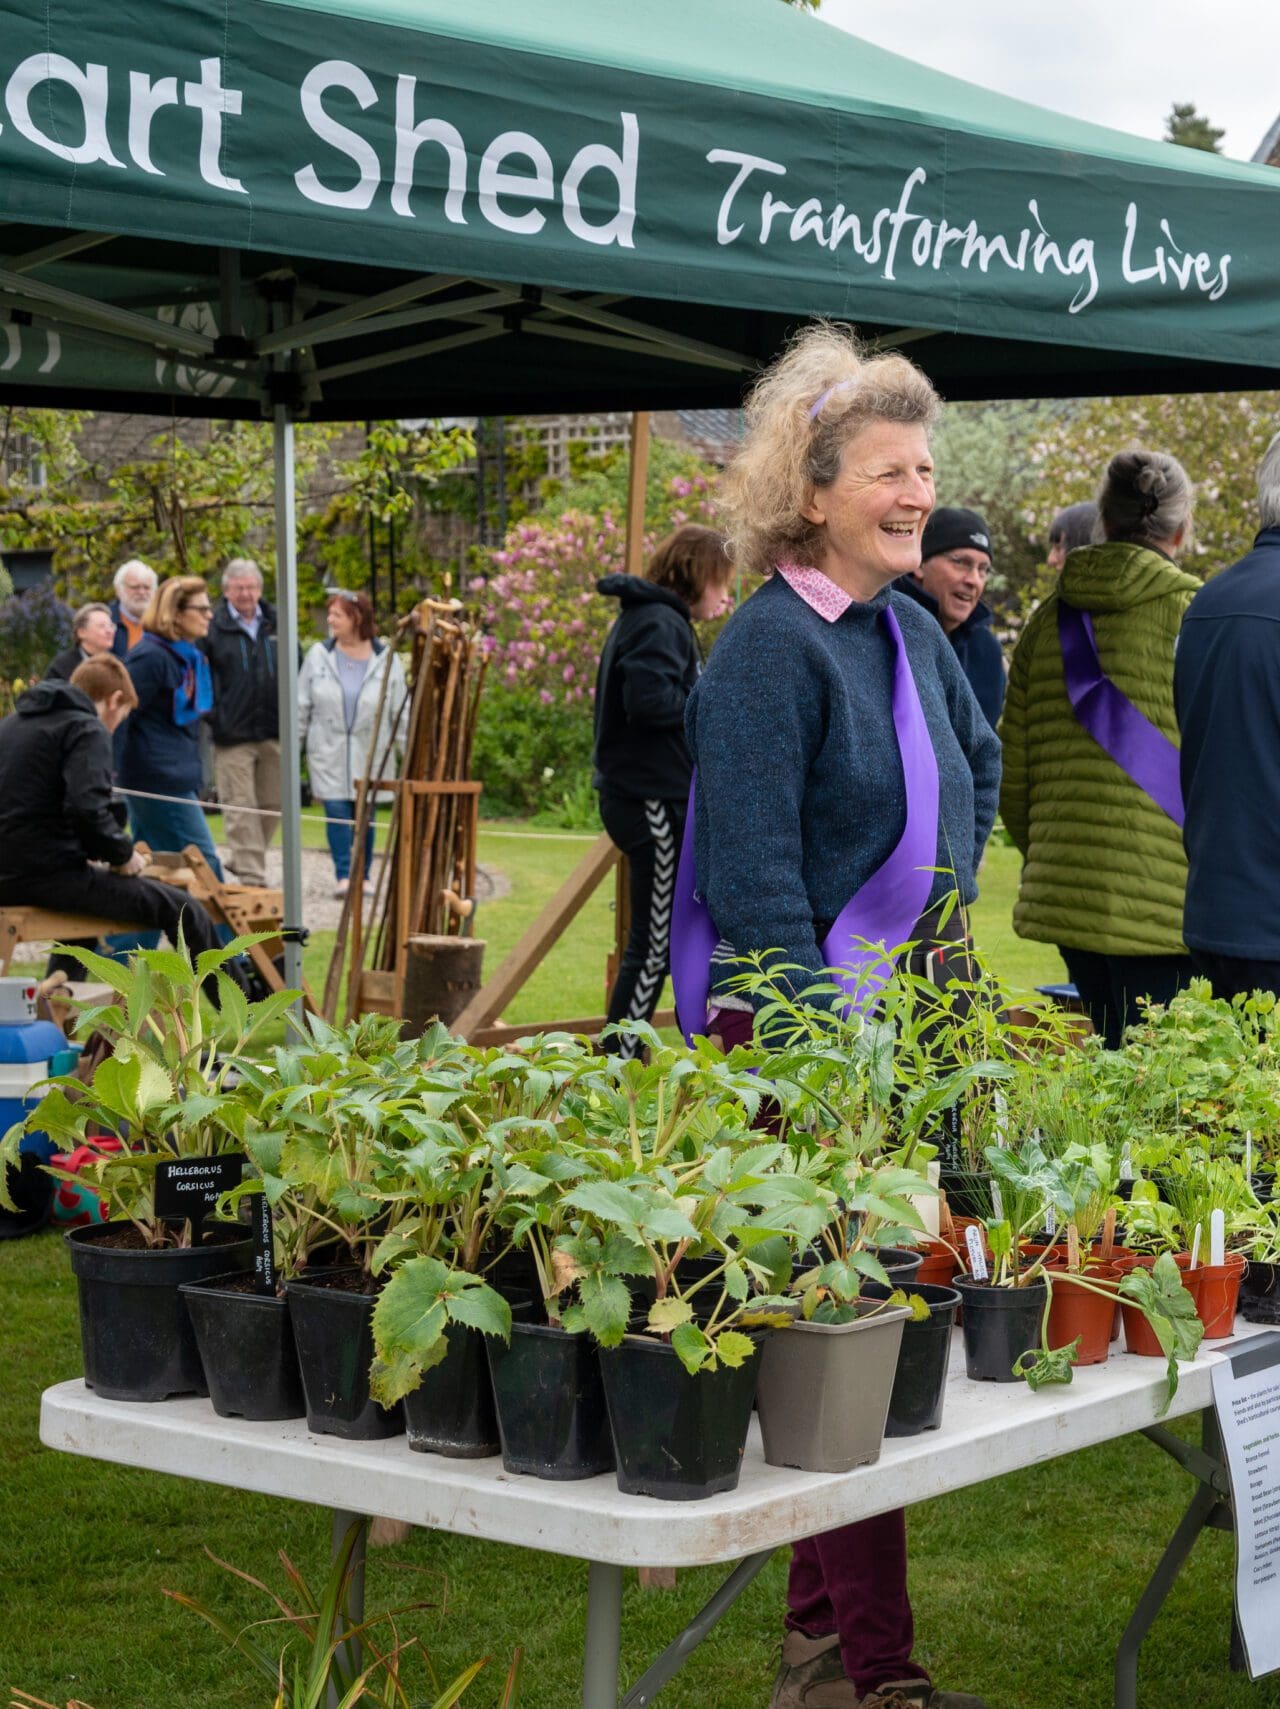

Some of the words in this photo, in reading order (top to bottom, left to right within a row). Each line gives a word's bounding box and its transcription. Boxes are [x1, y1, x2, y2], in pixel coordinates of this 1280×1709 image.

[0, 52, 249, 194] art
[294, 60, 639, 249] Shed
[705, 148, 1099, 313] Transforming
[1121, 202, 1231, 300] Lives
[168, 1165, 222, 1178] HELLEBORUS
[176, 1181, 215, 1192] CORSICUS
[264, 1249, 272, 1286] CORSICUS
